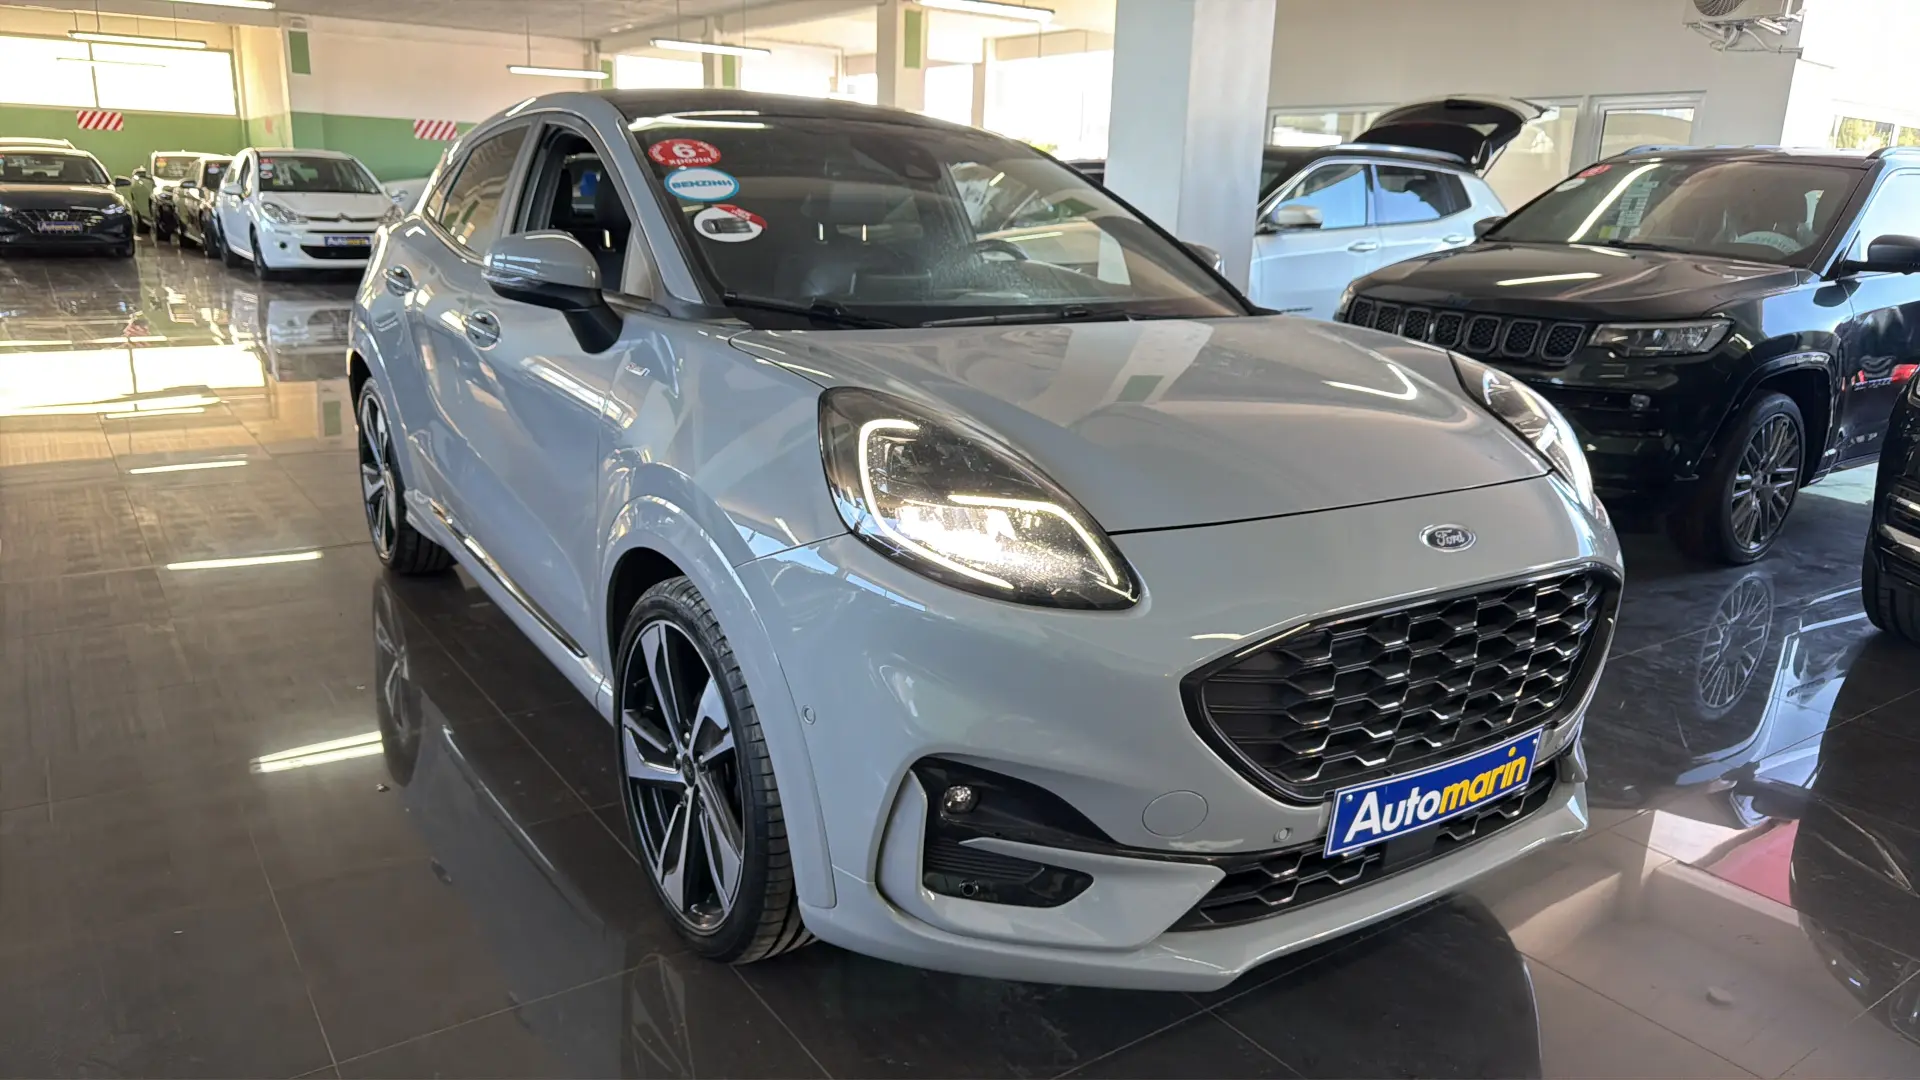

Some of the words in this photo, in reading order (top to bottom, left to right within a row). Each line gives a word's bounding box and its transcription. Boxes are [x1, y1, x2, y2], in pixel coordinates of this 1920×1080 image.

[672, 143, 696, 158] 6
[1435, 529, 1465, 546] Ford
[1343, 746, 1527, 844] Automarin
